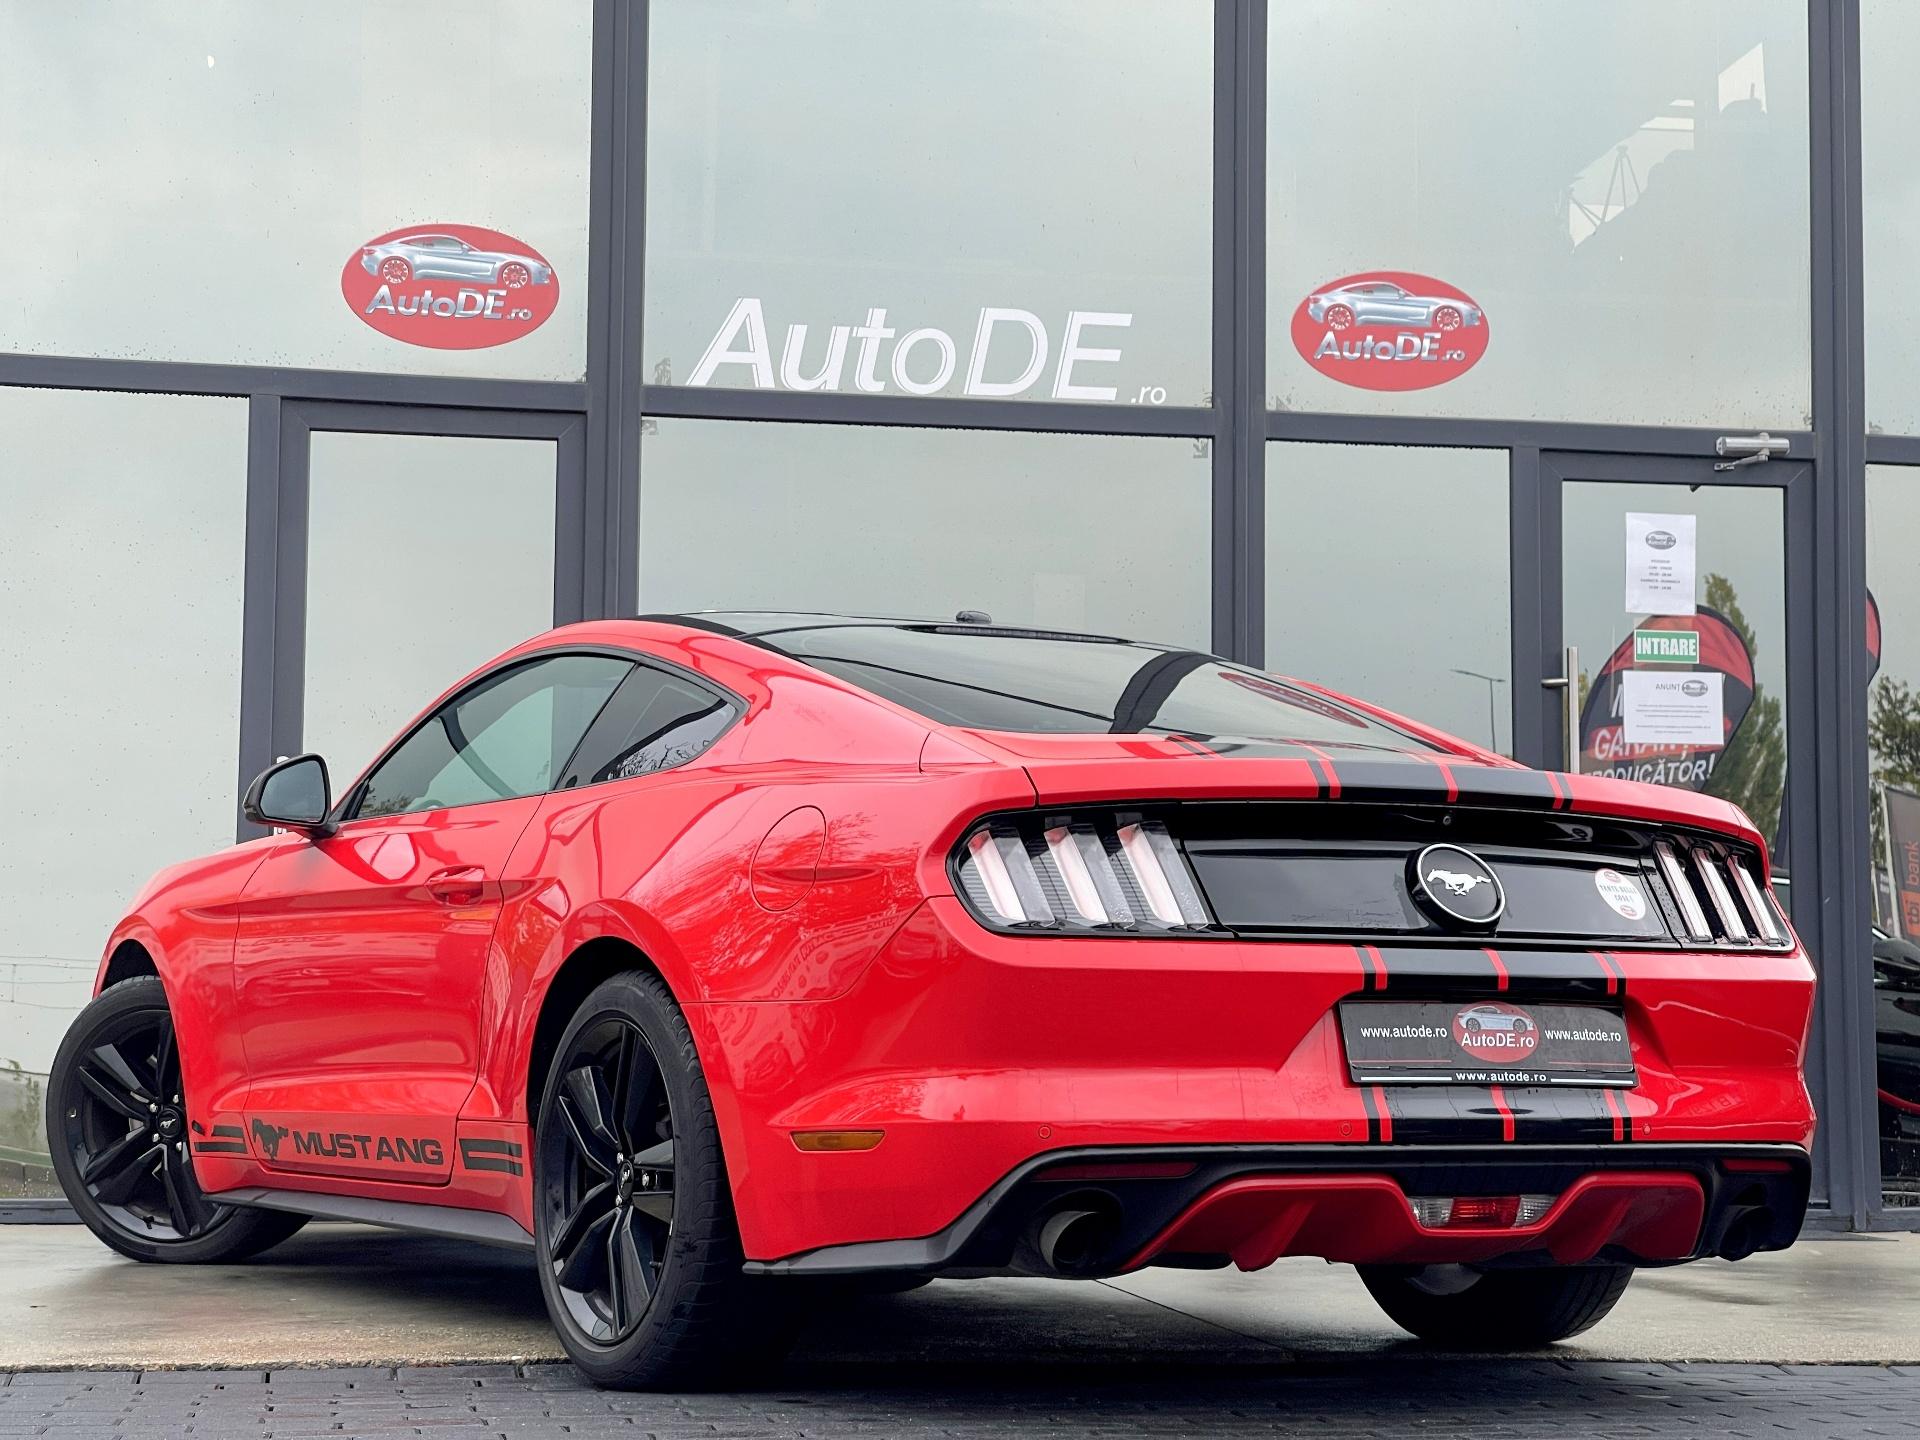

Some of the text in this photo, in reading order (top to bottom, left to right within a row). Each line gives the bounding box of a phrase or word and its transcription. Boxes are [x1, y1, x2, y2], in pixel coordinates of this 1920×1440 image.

[1636, 637, 1697, 656] INTRARE
[1905, 841, 1920, 886] bank
[1360, 1024, 1622, 1049] www.autode.ro AutoDE.ro www.autode.ro
[1455, 1071, 1547, 1083] www.autode.ro
[291, 1129, 444, 1166] MUSTANG
